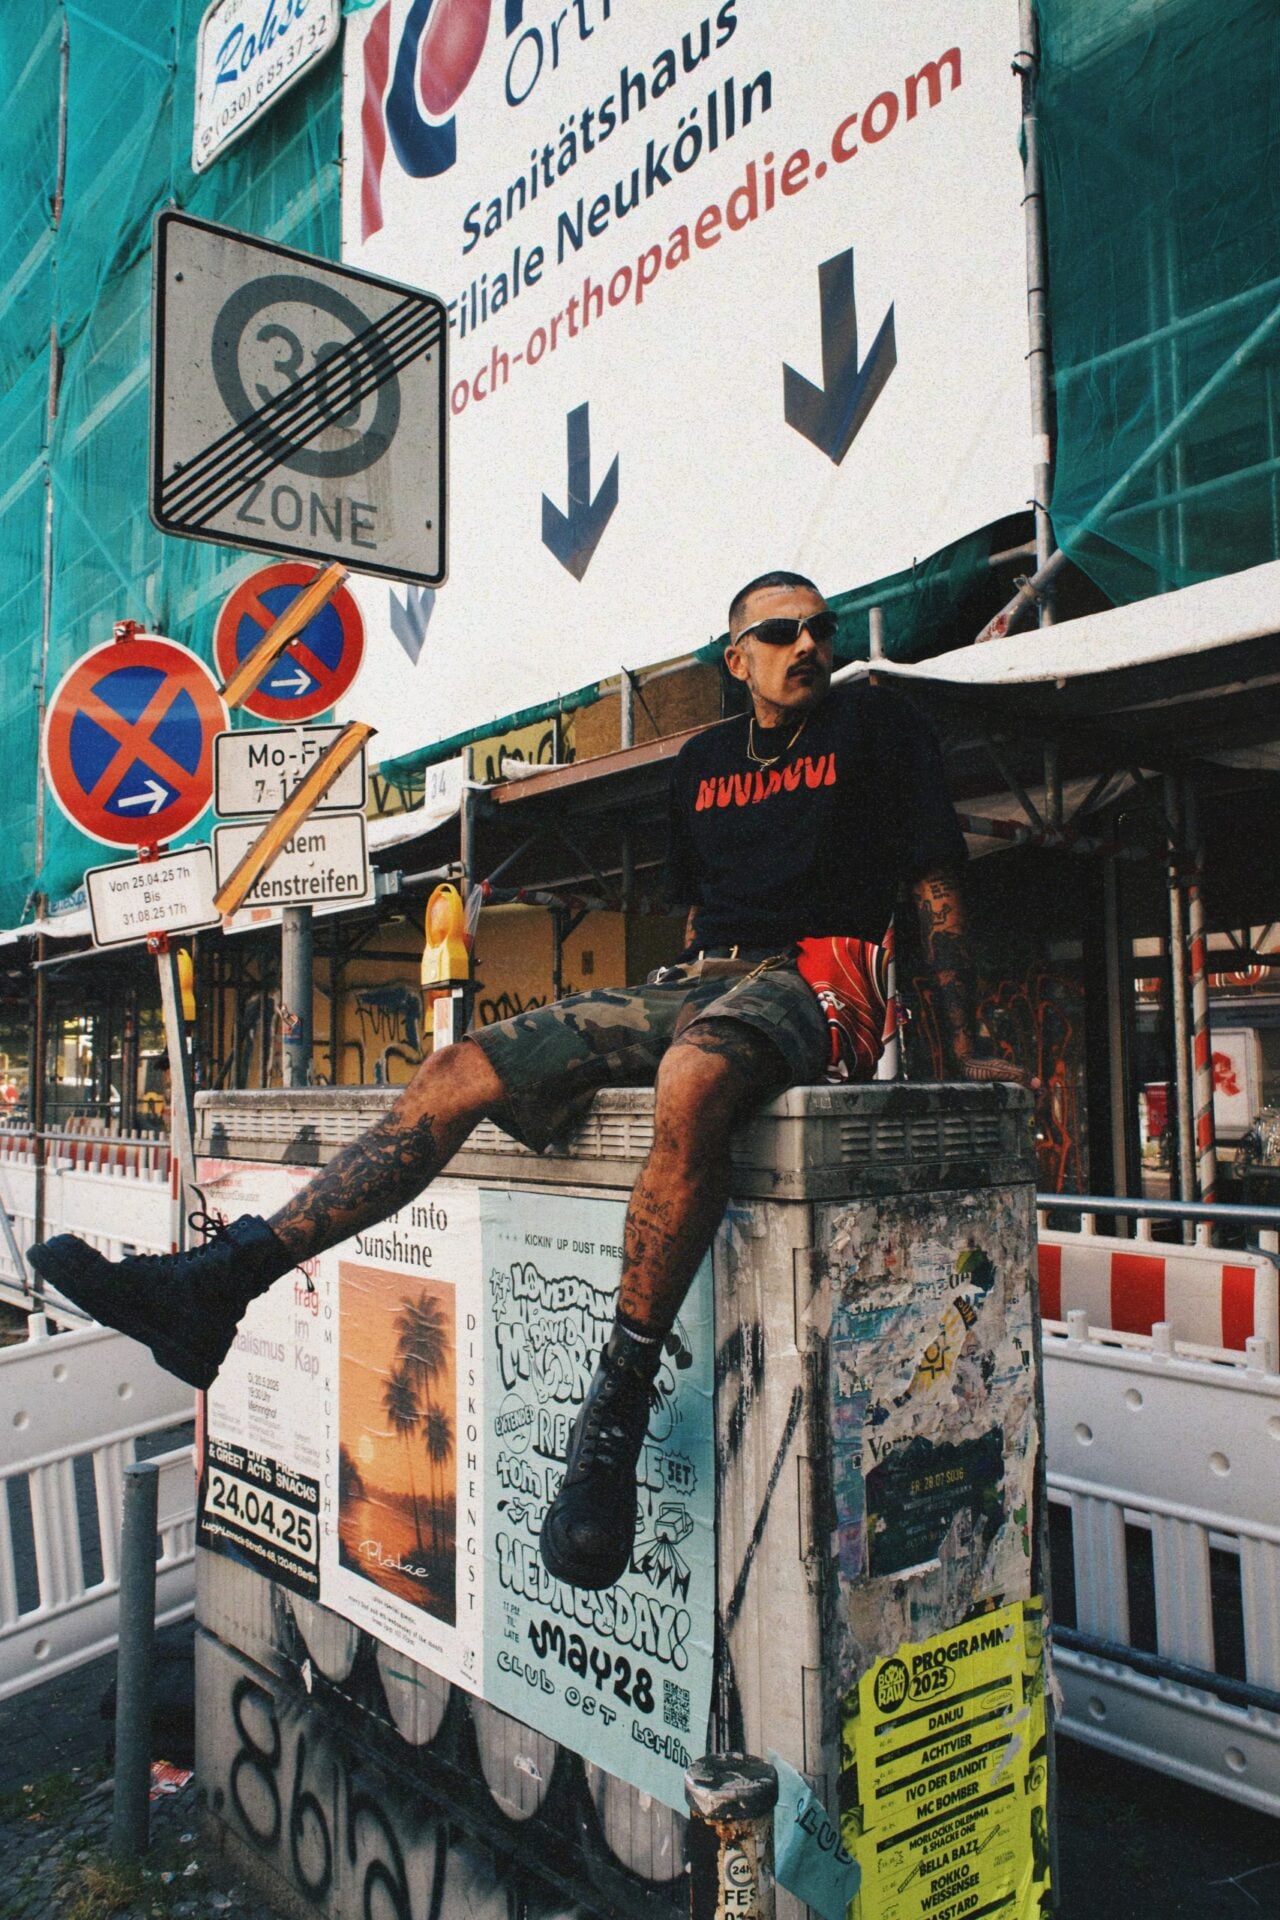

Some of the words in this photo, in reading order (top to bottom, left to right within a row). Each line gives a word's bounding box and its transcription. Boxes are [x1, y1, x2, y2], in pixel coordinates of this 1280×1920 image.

[505, 0, 610, 107] Ort
[216, 87, 251, 135] (030)
[463, 0, 738, 255] Sanitätshaus
[557, 70, 772, 265] Neukölln
[450, 46, 962, 415] och-orthopaedie.com
[255, 323, 362, 428] 30
[236, 475, 378, 550] ZONE
[285, 834, 326, 854] dem
[109, 881, 130, 893] Von
[132, 869, 174, 889] 25.04.25
[177, 867, 190, 879] 7h
[143, 891, 161, 903] Bis
[248, 868, 358, 899] tenstreifen
[122, 907, 165, 926] 31.08.25
[168, 904, 188, 917] 17h
[355, 1231, 432, 1268] Sunshine
[557, 1239, 569, 1250] UP
[573, 1241, 595, 1254] DUST
[600, 1244, 624, 1258] PRES
[216, 1447, 245, 1471] GREET
[247, 1461, 273, 1483] ACTS
[275, 1475, 317, 1503] SNACKS
[466, 1314, 477, 1610] DISKOHENGST
[667, 1461, 691, 1486] SET
[213, 1476, 312, 1552] 24.04.25
[503, 1631, 519, 1643] LATE
[912, 1667, 948, 1697] 2025
[565, 1686, 616, 1725] OST
[929, 1706, 964, 1731] DANJU
[921, 1733, 972, 1764] ACHTVIER
[906, 1784, 926, 1802] IVO
[928, 1777, 947, 1797] DER
[949, 1757, 988, 1784] BANDIT
[917, 1800, 934, 1819] MC
[936, 1782, 979, 1810] BOMBER
[955, 1807, 989, 1830] DILEMMA
[922, 1845, 928, 1855] &
[930, 1830, 959, 1852] SHACKE
[960, 1823, 976, 1837] ONE
[919, 1853, 950, 1877] BELLA
[952, 1839, 980, 1862] BAZZ
[921, 1872, 980, 1911] WEISSENSEE
[930, 1864, 970, 1893] ROKKO
[925, 1894, 979, 1920] ASSTARD
